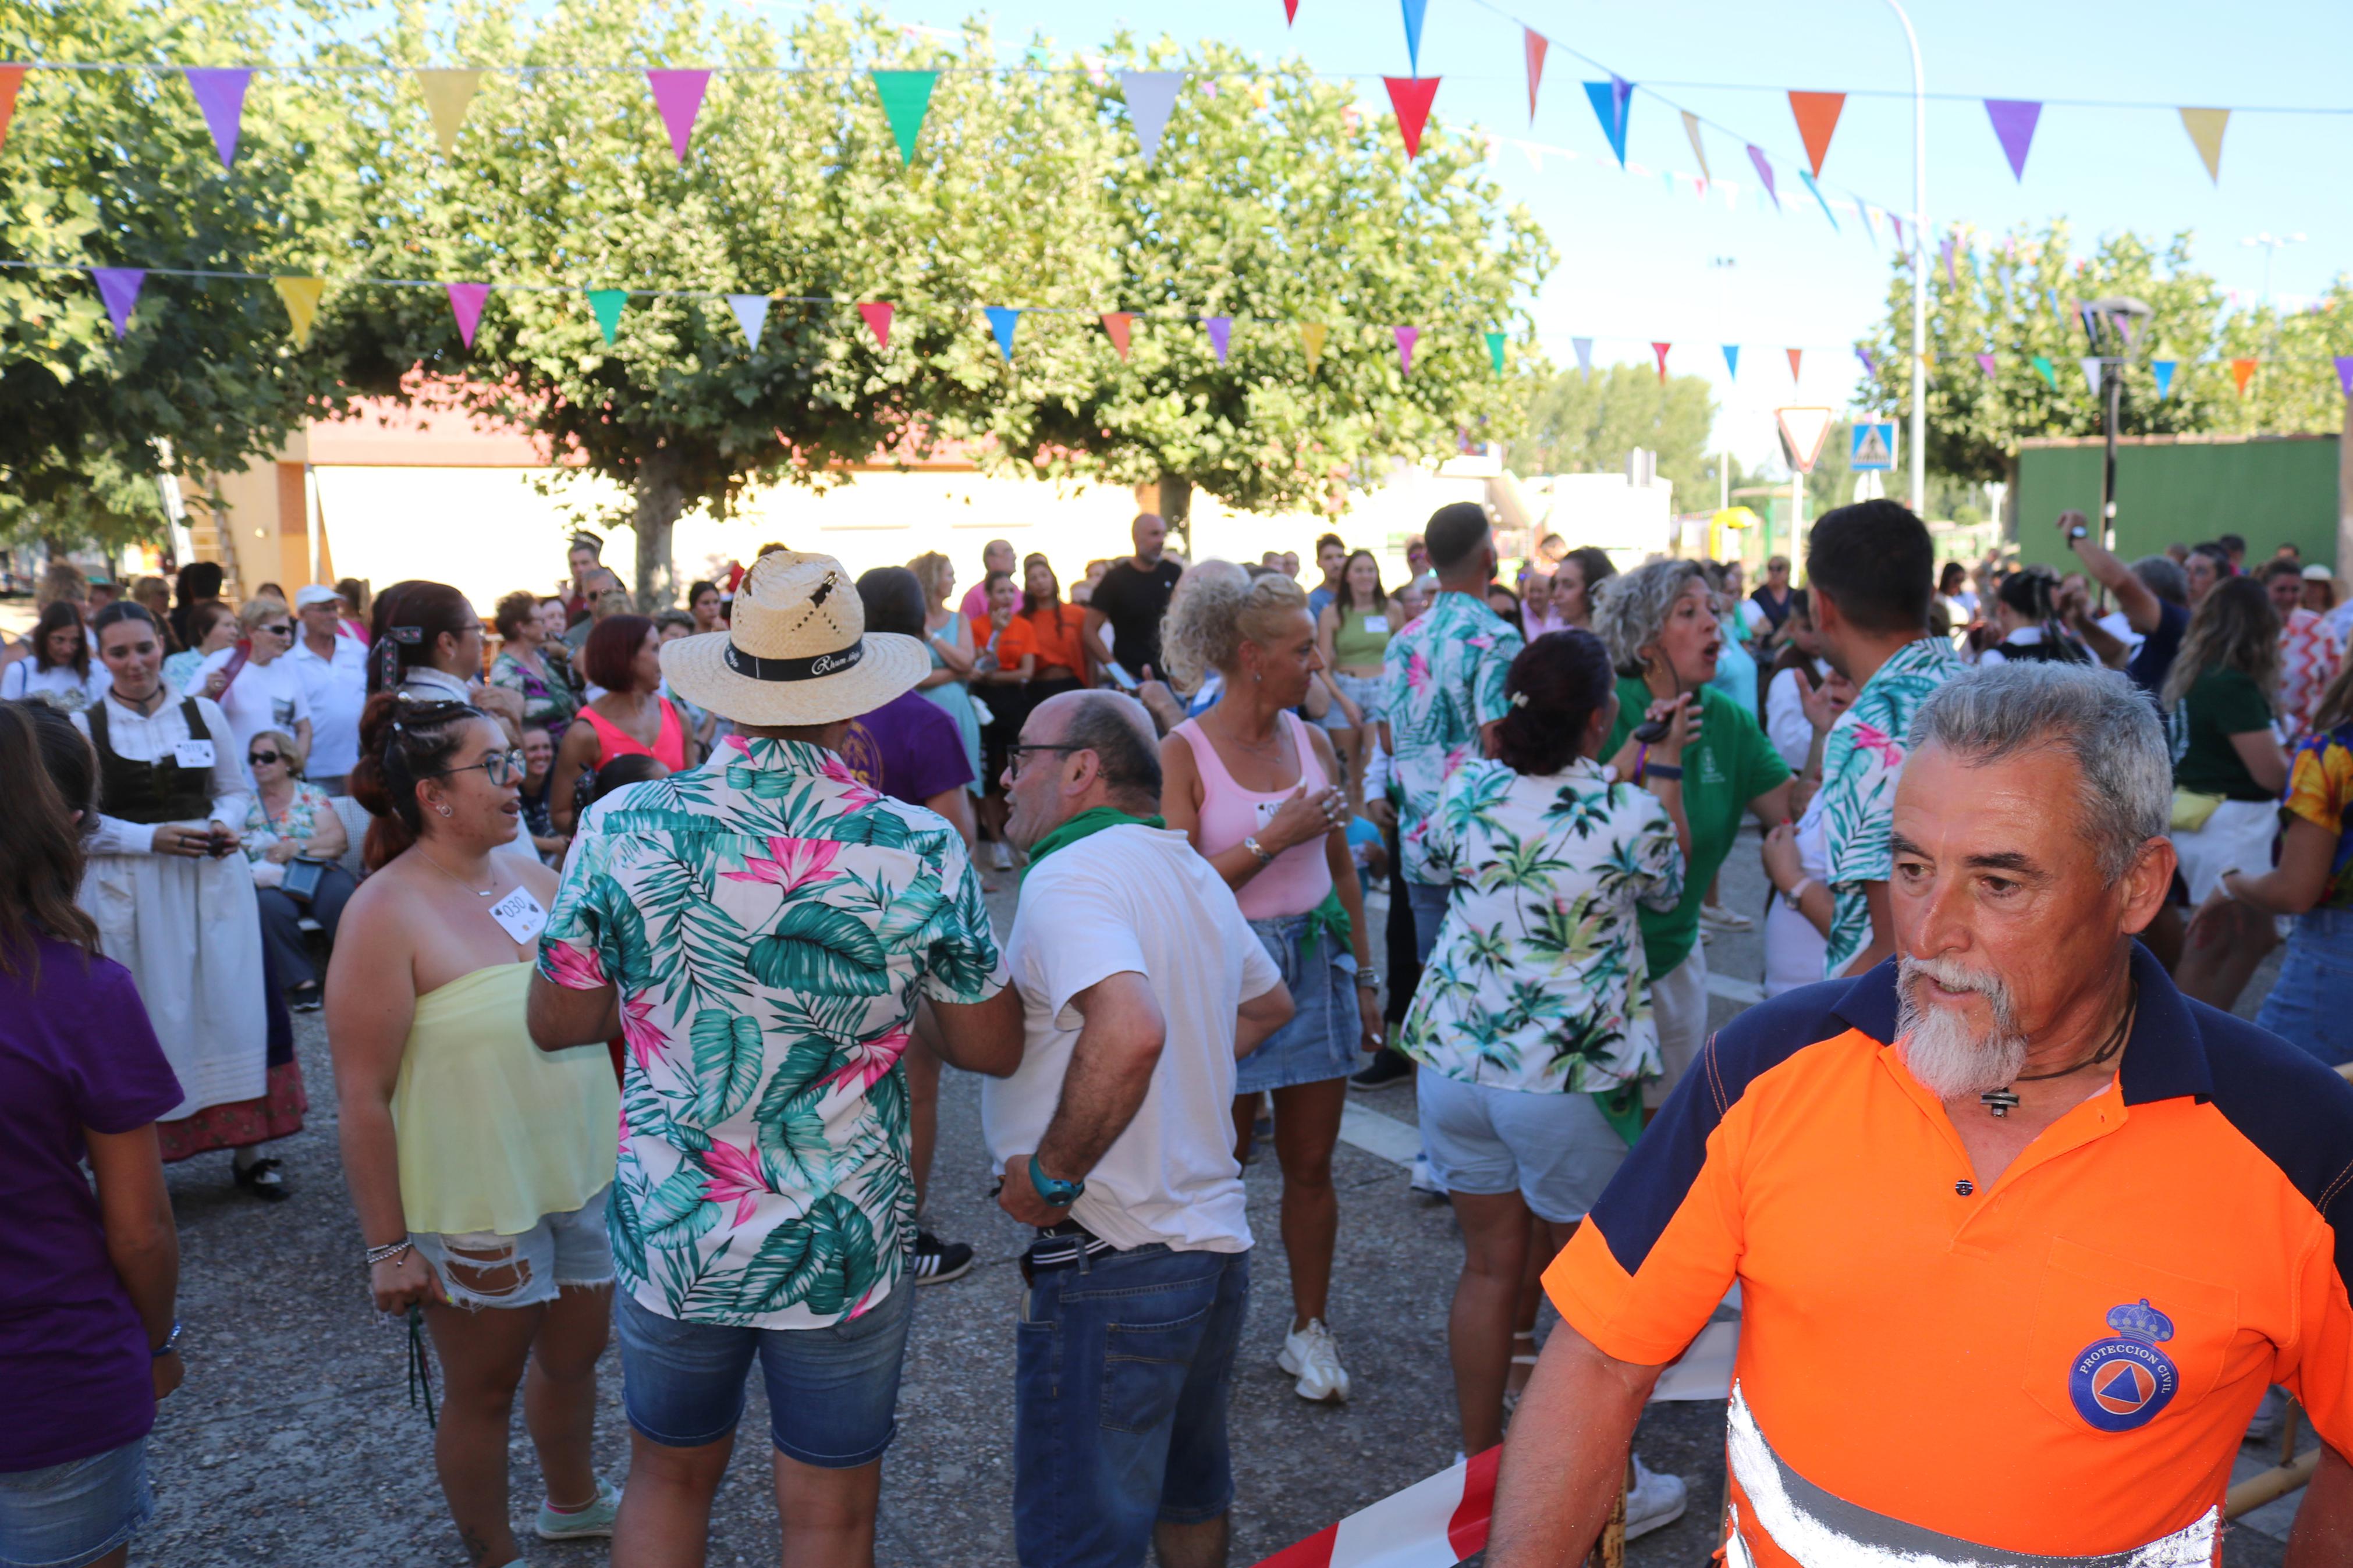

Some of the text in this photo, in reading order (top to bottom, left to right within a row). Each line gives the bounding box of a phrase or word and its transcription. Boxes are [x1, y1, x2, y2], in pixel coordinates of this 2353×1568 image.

[811, 655, 846, 675] Rhum
[502, 896, 526, 918] 030
[2079, 1345, 2172, 1393] PROTECCION CIVIL
